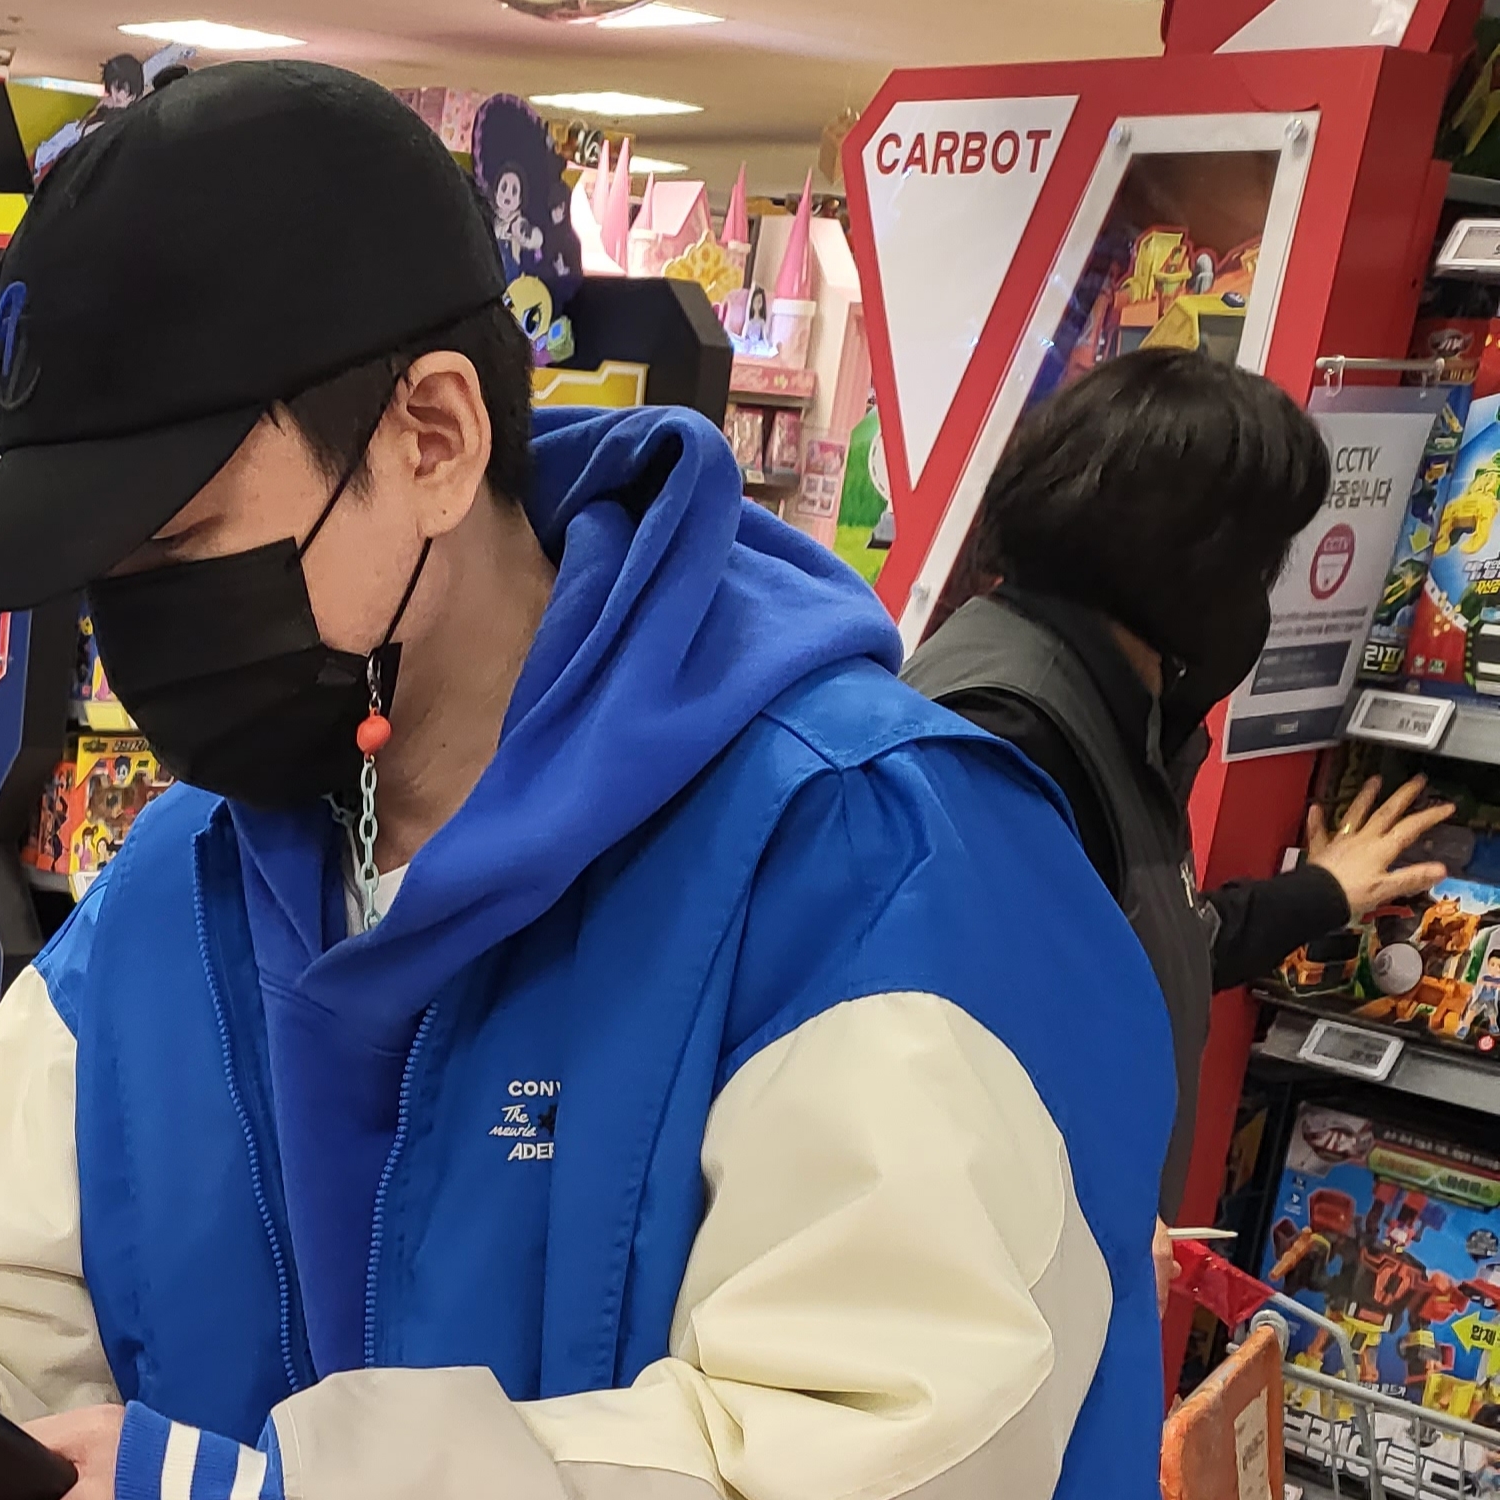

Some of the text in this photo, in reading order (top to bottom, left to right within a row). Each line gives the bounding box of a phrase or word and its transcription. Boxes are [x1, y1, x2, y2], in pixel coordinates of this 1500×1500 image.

[876, 130, 1052, 174] CARBOT
[1336, 447, 1381, 473] CCTV
[1326, 478, 1392, 508] 중입니다
[501, 1104, 529, 1123] The
[1470, 1324, 1496, 1346] 합체
